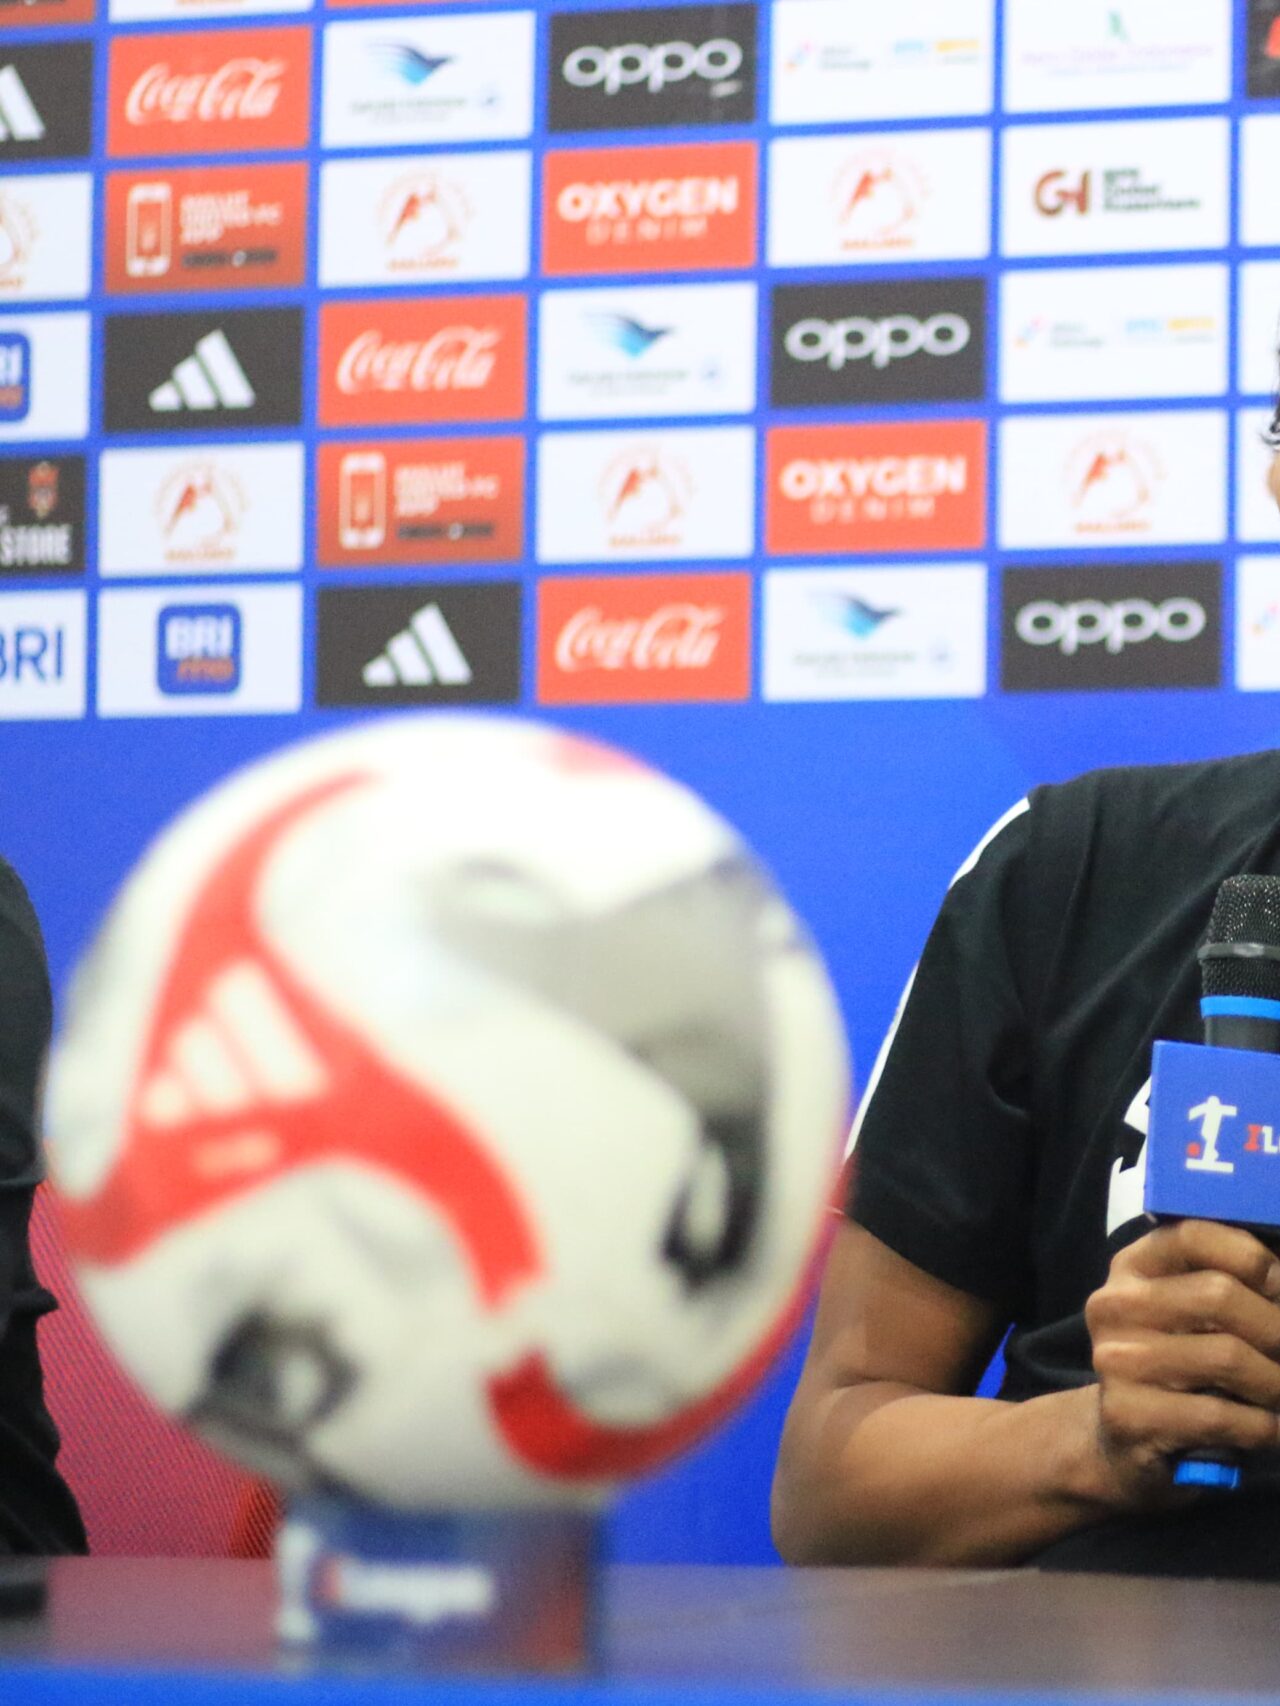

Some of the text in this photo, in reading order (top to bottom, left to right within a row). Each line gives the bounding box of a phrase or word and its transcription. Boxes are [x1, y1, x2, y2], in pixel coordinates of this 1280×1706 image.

[556, 177, 738, 222] OXYGEN
[780, 456, 967, 500] OXYGEN
[166, 615, 233, 660] BRI
